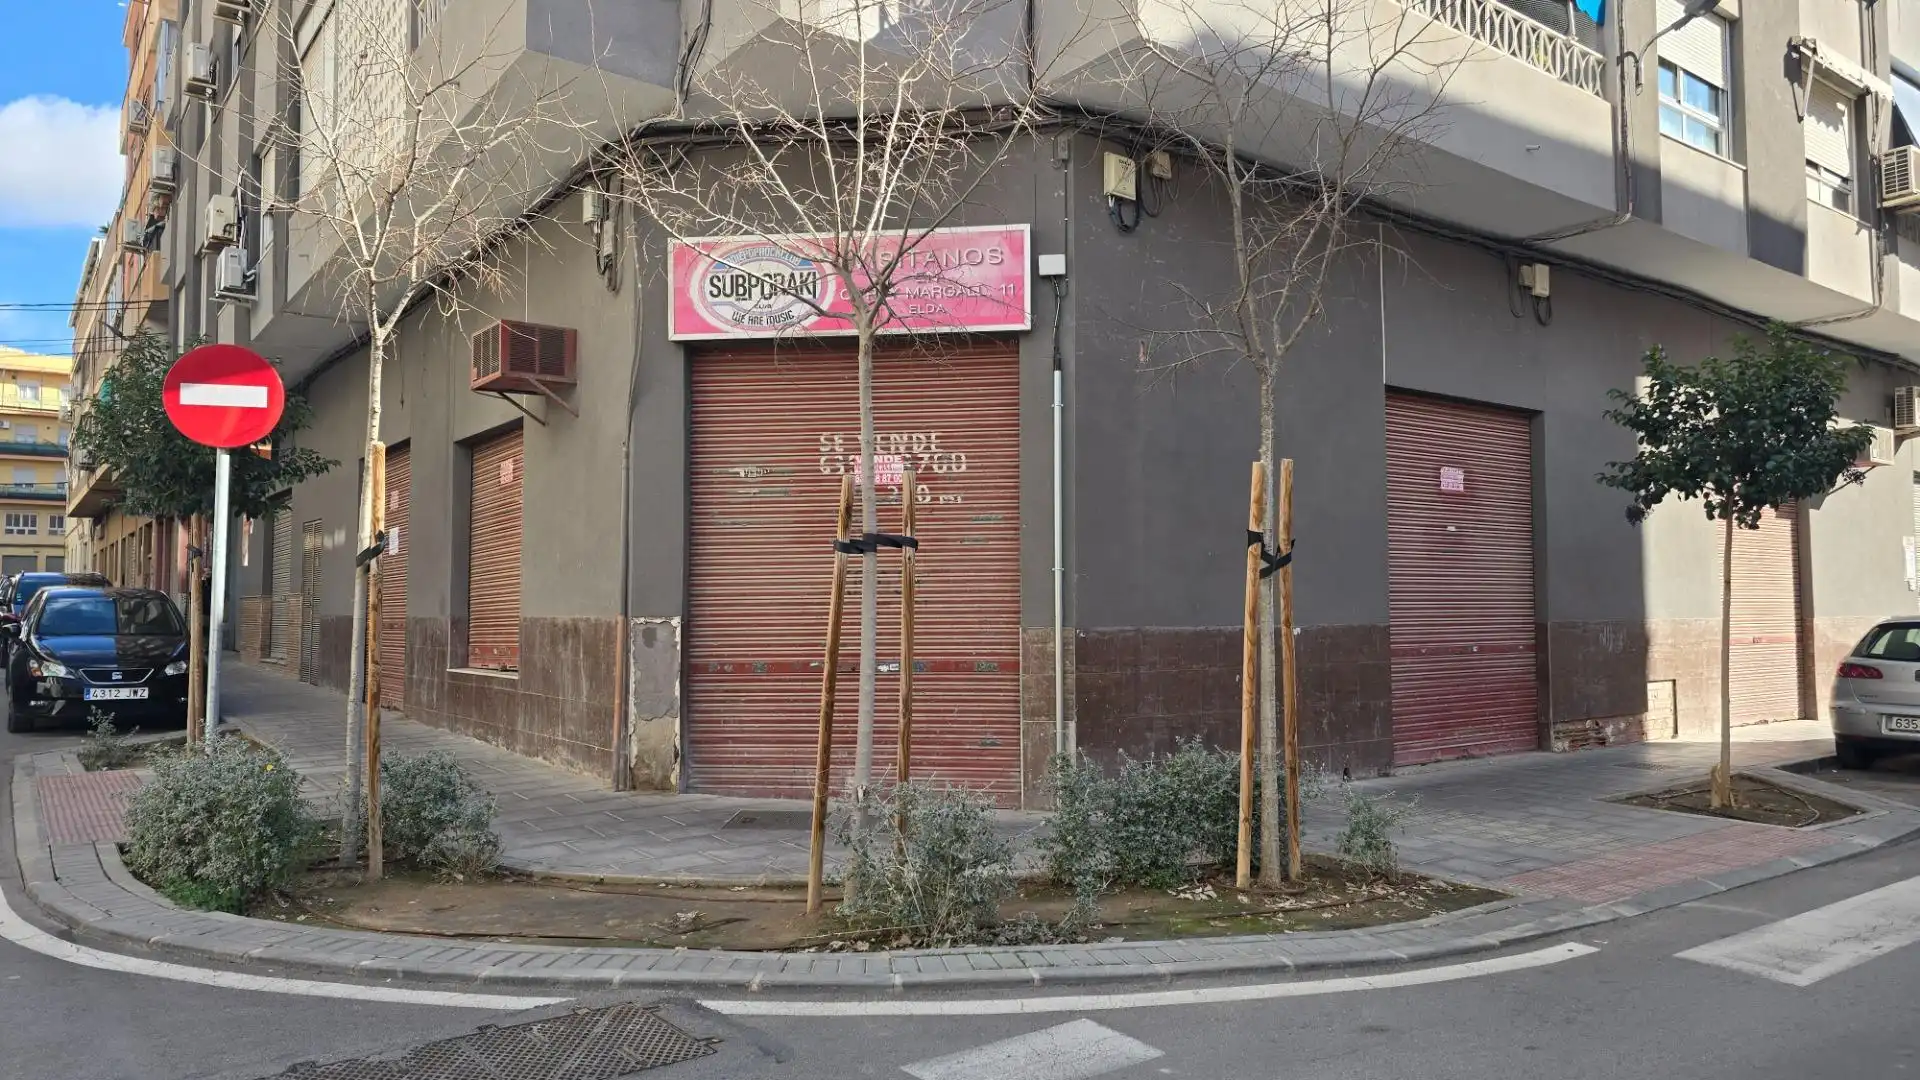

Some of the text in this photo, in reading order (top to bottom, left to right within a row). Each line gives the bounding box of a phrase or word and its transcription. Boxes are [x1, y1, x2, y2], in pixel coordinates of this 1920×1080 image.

[709, 271, 817, 301] SUBPORAKI
[1000, 283, 1016, 297] 11
[908, 303, 945, 314] ELDA
[748, 316, 763, 326] ARE
[766, 310, 795, 326] MUSIC
[858, 432, 943, 454] ENDE
[855, 455, 903, 465] VNDE
[92, 688, 146, 698] 4312 JWZ
